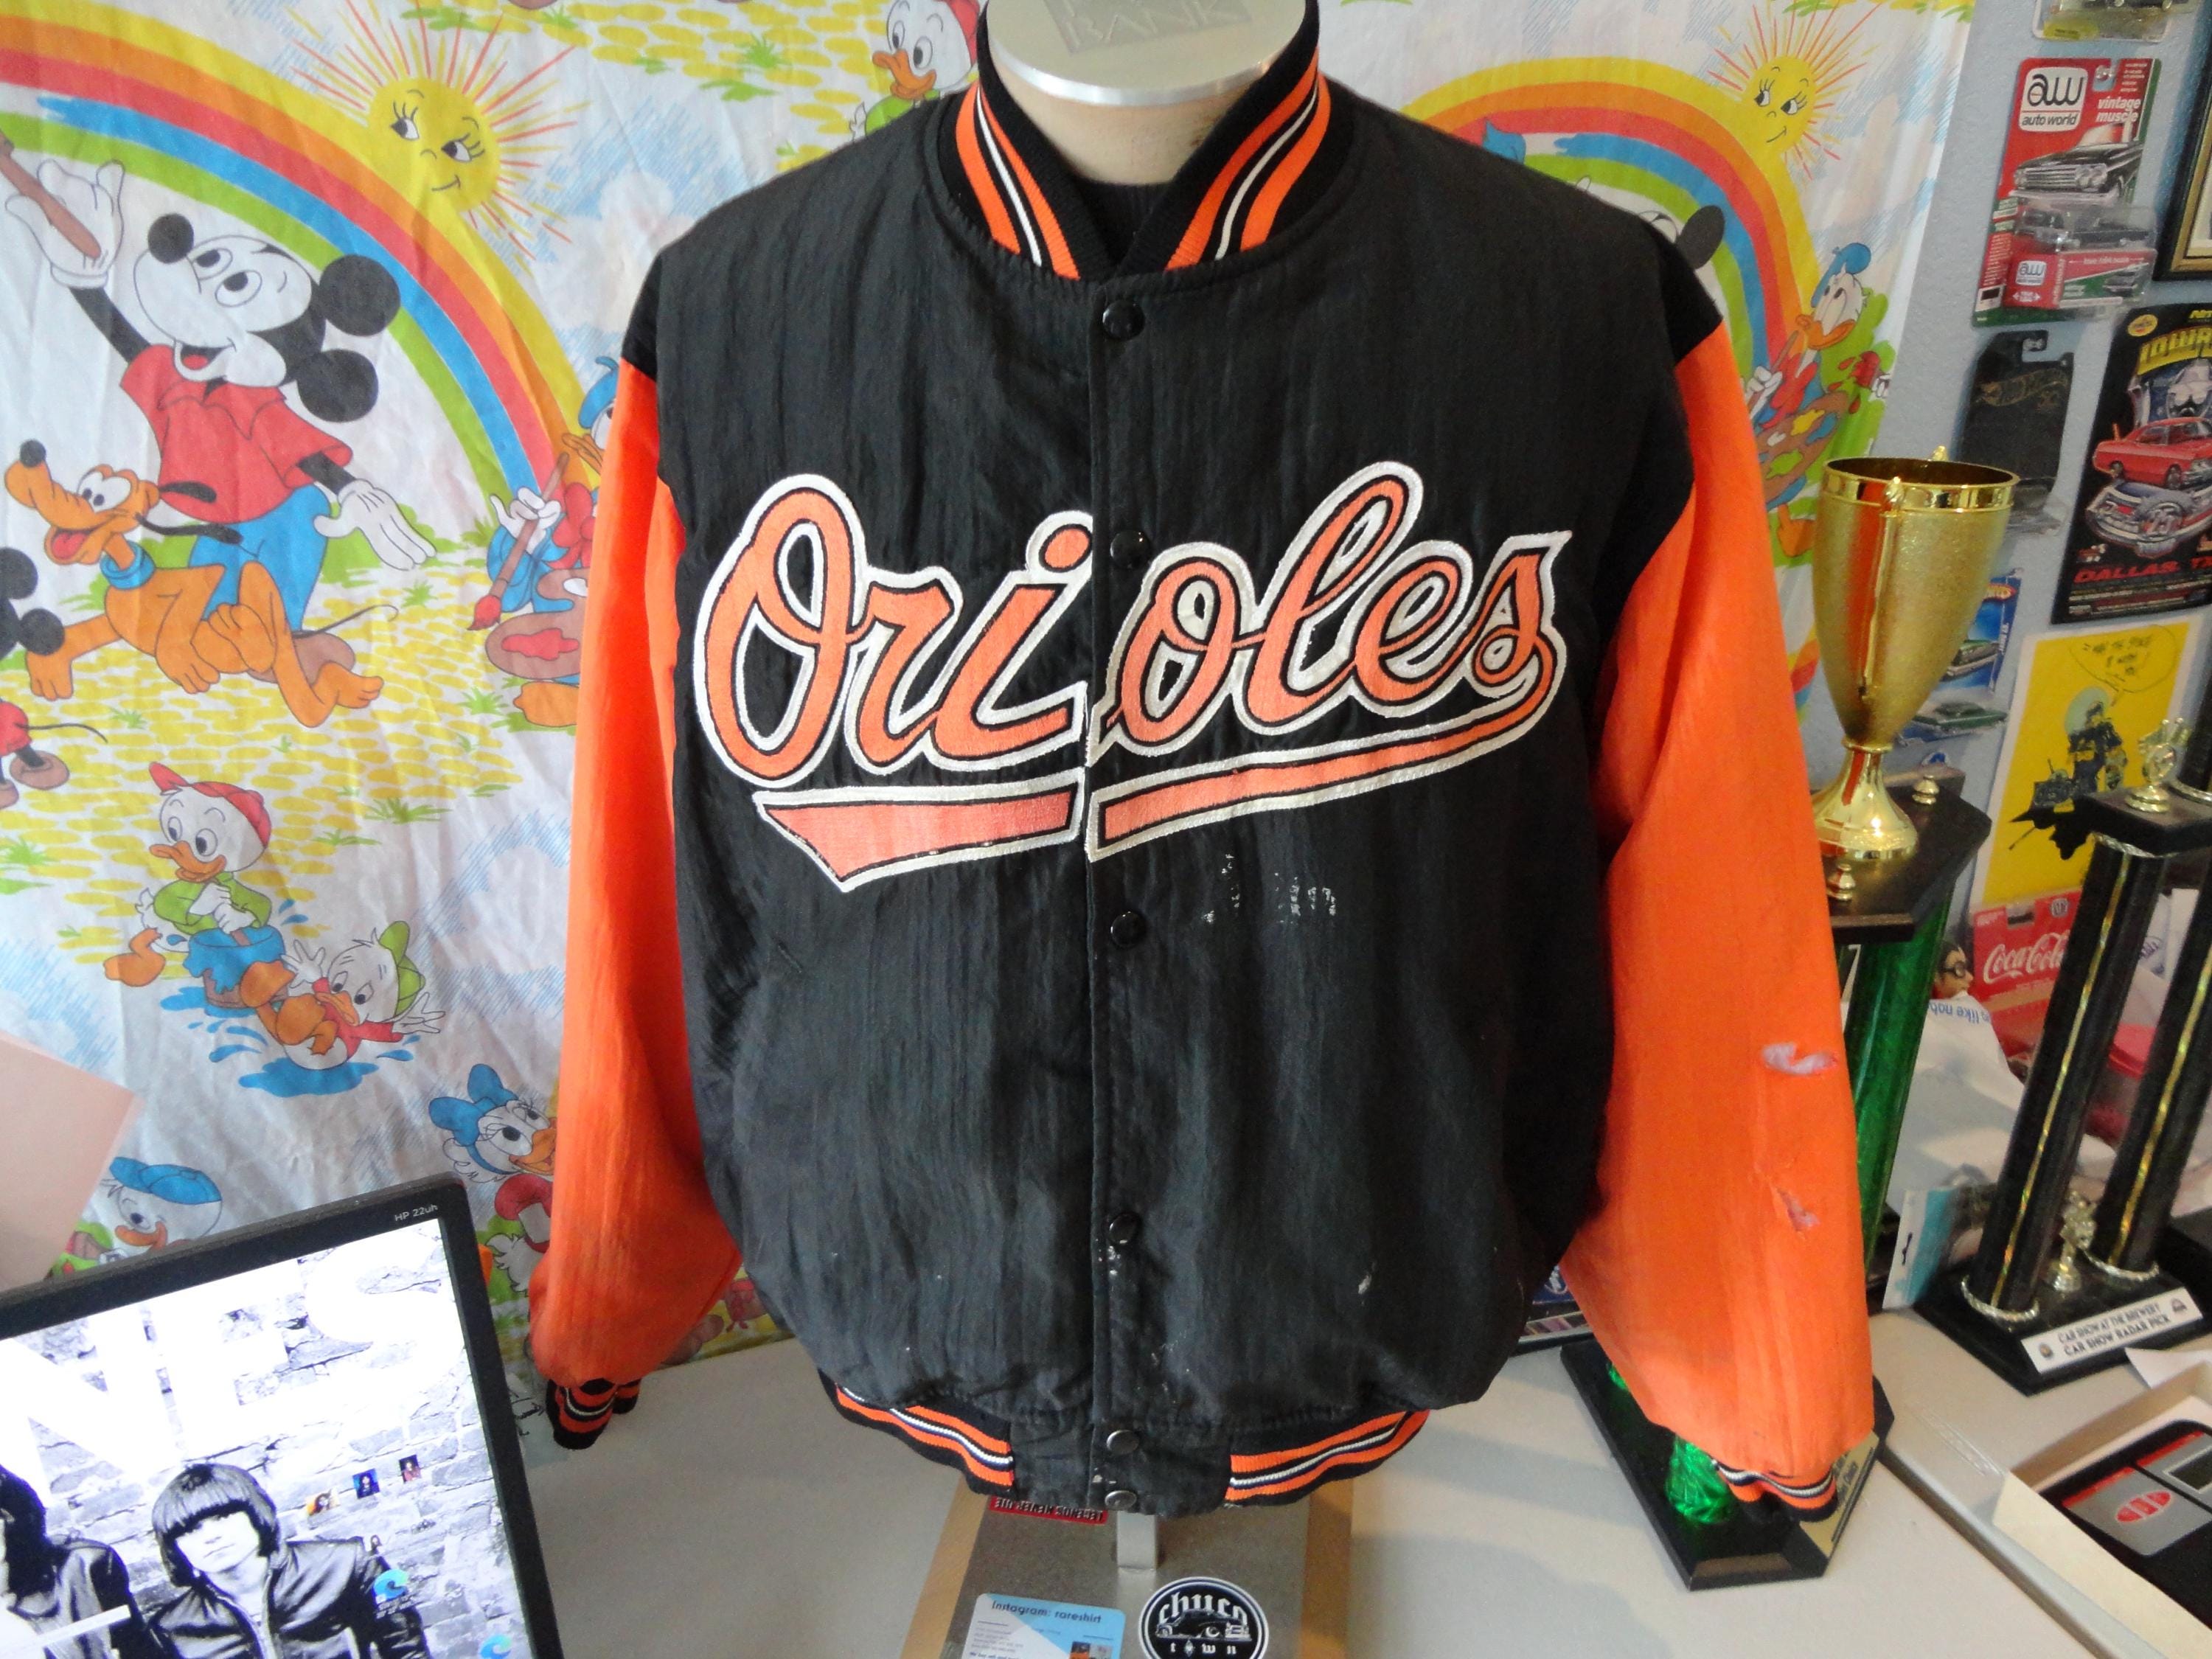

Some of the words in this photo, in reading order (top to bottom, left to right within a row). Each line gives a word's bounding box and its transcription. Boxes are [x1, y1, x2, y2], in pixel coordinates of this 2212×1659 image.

[2098, 96, 2141, 112] vintage
[2022, 115, 2045, 126] auto
[2048, 114, 2078, 125] world
[694, 460, 1572, 790] Orioles
[394, 1211, 409, 1222] HP
[413, 1204, 438, 1217] 22uh
[2064, 1342, 2086, 1356] CAR
[2086, 1332, 2114, 1349] SHOW
[2115, 1321, 2149, 1339] RADAR
[992, 1600, 1051, 1616] Instagram:
[1054, 1610, 1102, 1624] rareshirt
